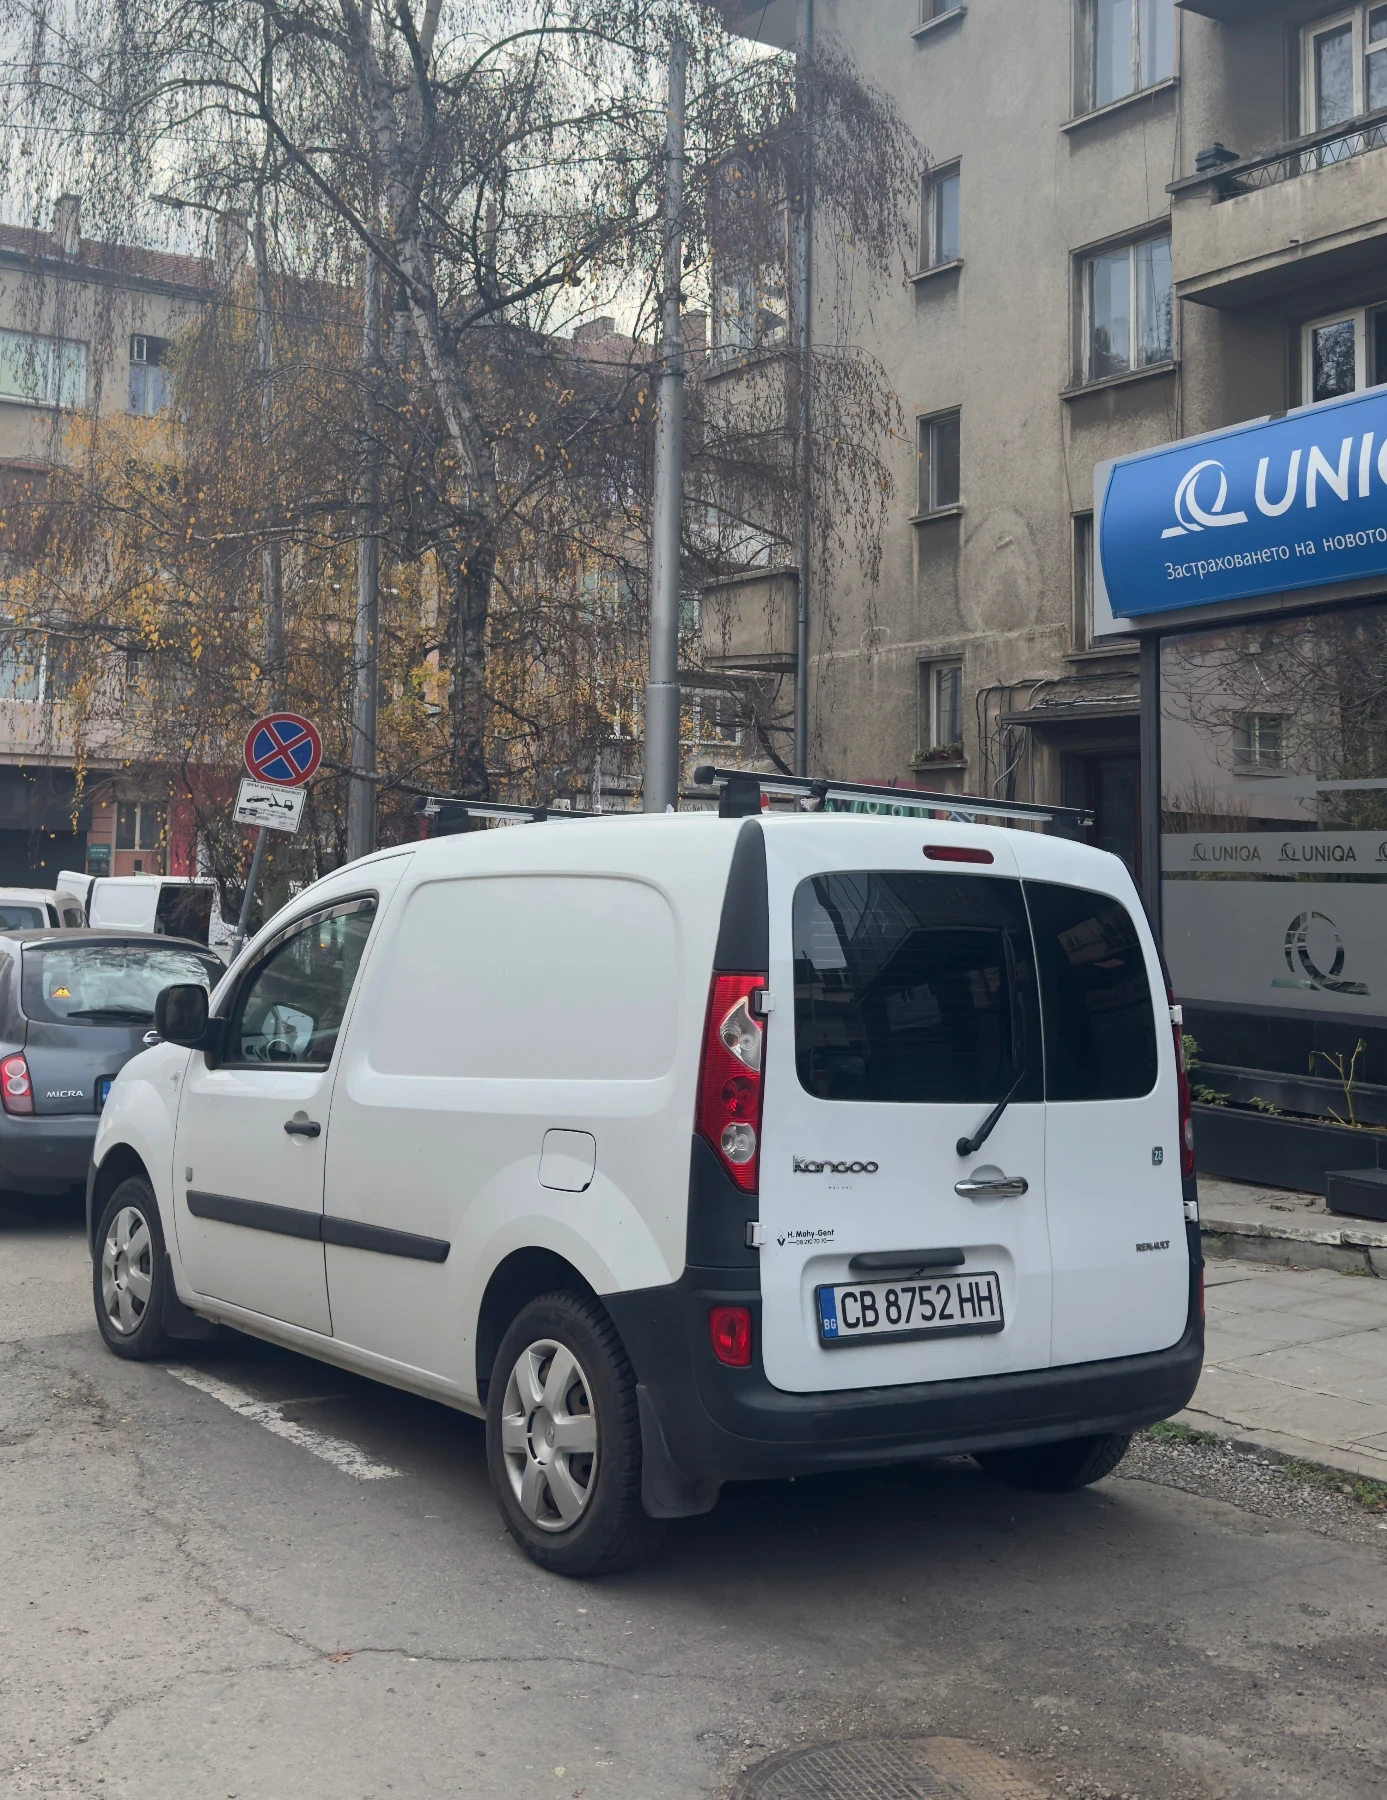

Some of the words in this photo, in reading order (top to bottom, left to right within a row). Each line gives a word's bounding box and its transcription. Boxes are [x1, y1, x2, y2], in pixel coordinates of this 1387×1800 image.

[1254, 431, 1387, 517] UNI
[1165, 545, 1289, 579] Застраховането
[1295, 540, 1316, 557] на
[1322, 527, 1387, 552] новото
[1212, 845, 1262, 862] UNIQA
[1302, 845, 1357, 862] UNIQA
[46, 1090, 84, 1098] MICRA
[1136, 1240, 1170, 1252] RENAULT
[840, 1290, 880, 1329] CB
[885, 1283, 954, 1325] 8752
[956, 1280, 996, 1319] HH
[824, 1318, 836, 1330] BG
